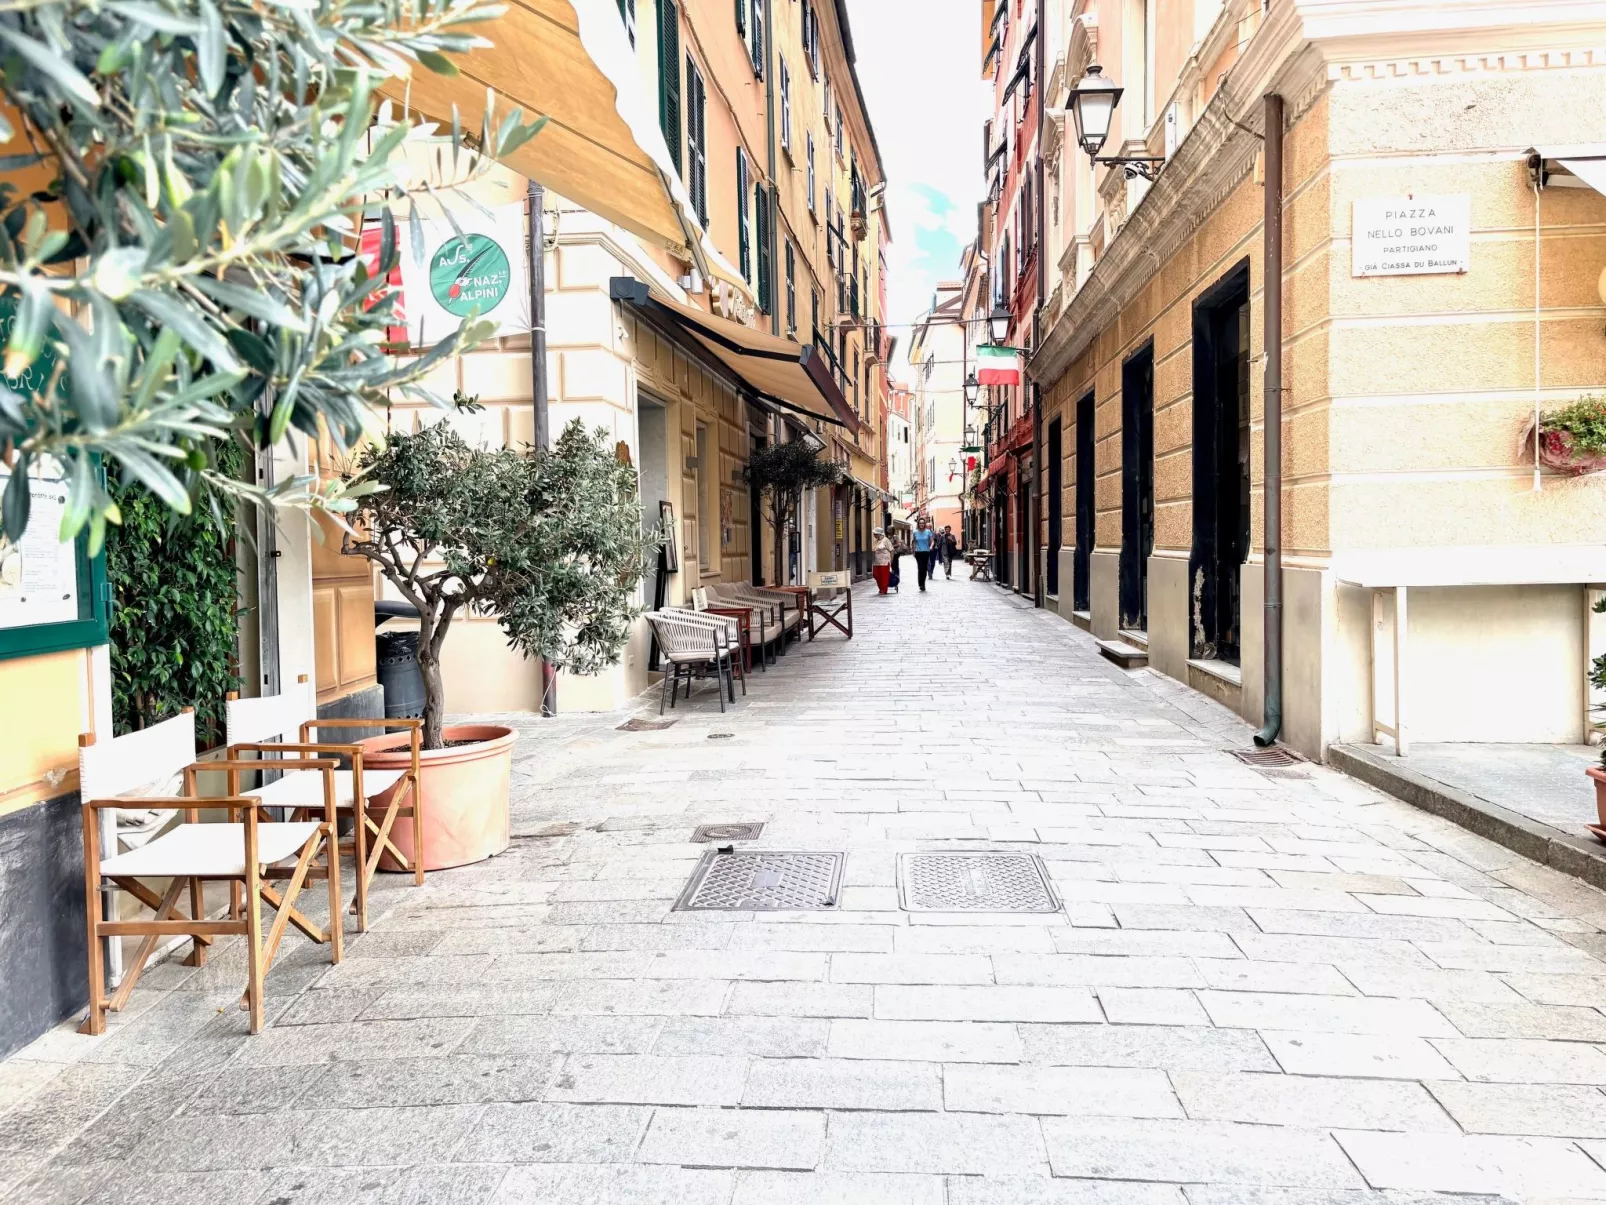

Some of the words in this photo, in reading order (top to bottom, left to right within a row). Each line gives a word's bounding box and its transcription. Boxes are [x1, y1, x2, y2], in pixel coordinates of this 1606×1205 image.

[1385, 208, 1437, 220] PIAZZA
[1367, 228, 1403, 239] NELLO
[1410, 225, 1454, 236] BOVANI
[1383, 244, 1438, 253] PARTIGIANO
[460, 287, 499, 302] ALPINI
